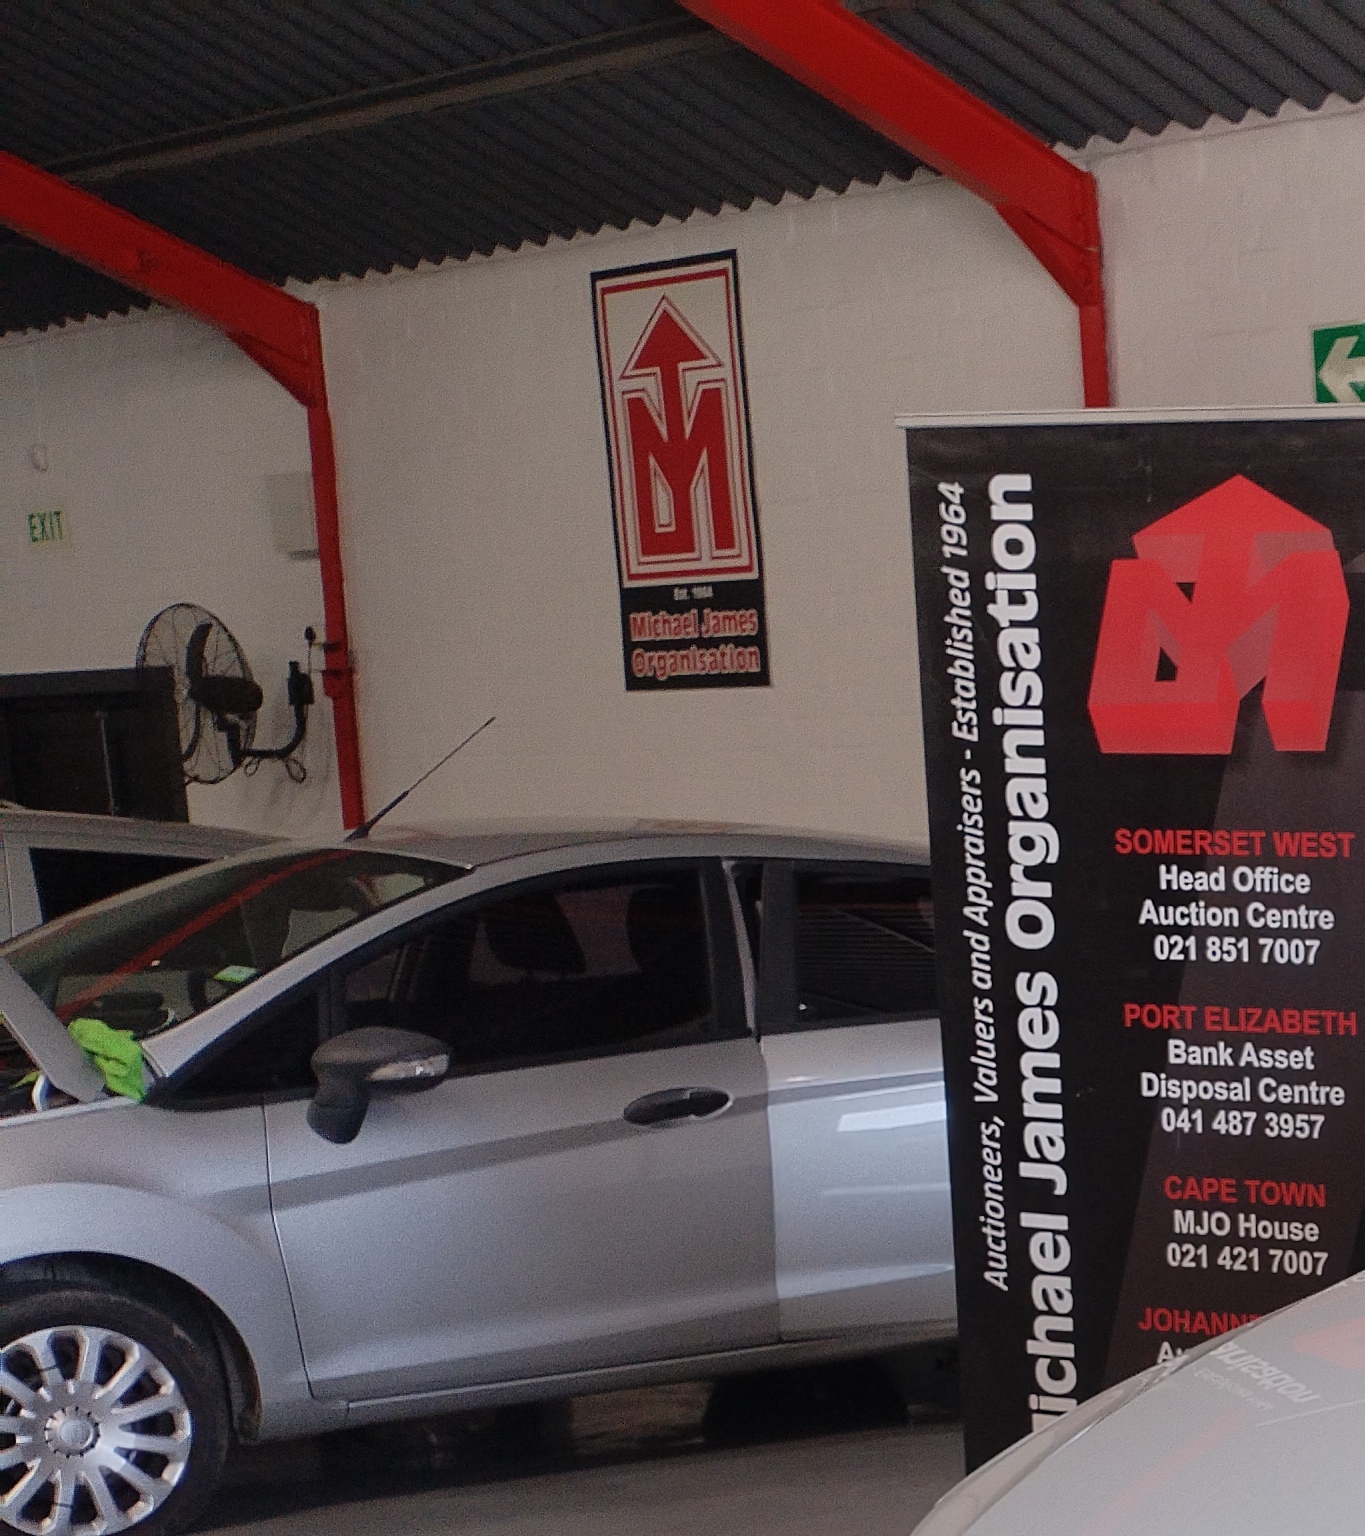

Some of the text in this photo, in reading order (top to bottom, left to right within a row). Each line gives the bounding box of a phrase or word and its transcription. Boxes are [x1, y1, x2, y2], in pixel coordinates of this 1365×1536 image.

[28, 511, 63, 542] EXIT
[938, 481, 968, 558] 1964
[629, 607, 758, 641] Michael James
[632, 642, 761, 681] Organisation
[942, 566, 979, 742] Established
[985, 473, 1060, 950] Organisation
[952, 768, 994, 927] Appraisers
[1115, 828, 1355, 858] SOMERSET WEST
[1160, 865, 1310, 893] Head Office
[1139, 899, 1334, 929] Auction Centre
[968, 930, 993, 990] and
[1155, 935, 1320, 964] 021 851 7007
[1124, 1003, 1357, 1036] PORT ELIZABETH
[970, 996, 999, 1102] Valuers
[1168, 1039, 1314, 1070] Bank Asset
[1016, 971, 1070, 1196] James
[1142, 1072, 1344, 1105] Disposal Centre
[1162, 1108, 1324, 1138] 041 487 3957
[979, 1115, 1008, 1292] Auctioneers,
[1164, 1175, 1326, 1208] CAPE TOWN
[1174, 1210, 1319, 1241] MJO House
[1167, 1243, 1207, 1268] 021
[1218, 1246, 1258, 1271] 421
[1269, 1249, 1328, 1275] 7007
[1138, 1307, 1261, 1336] JOHANN
